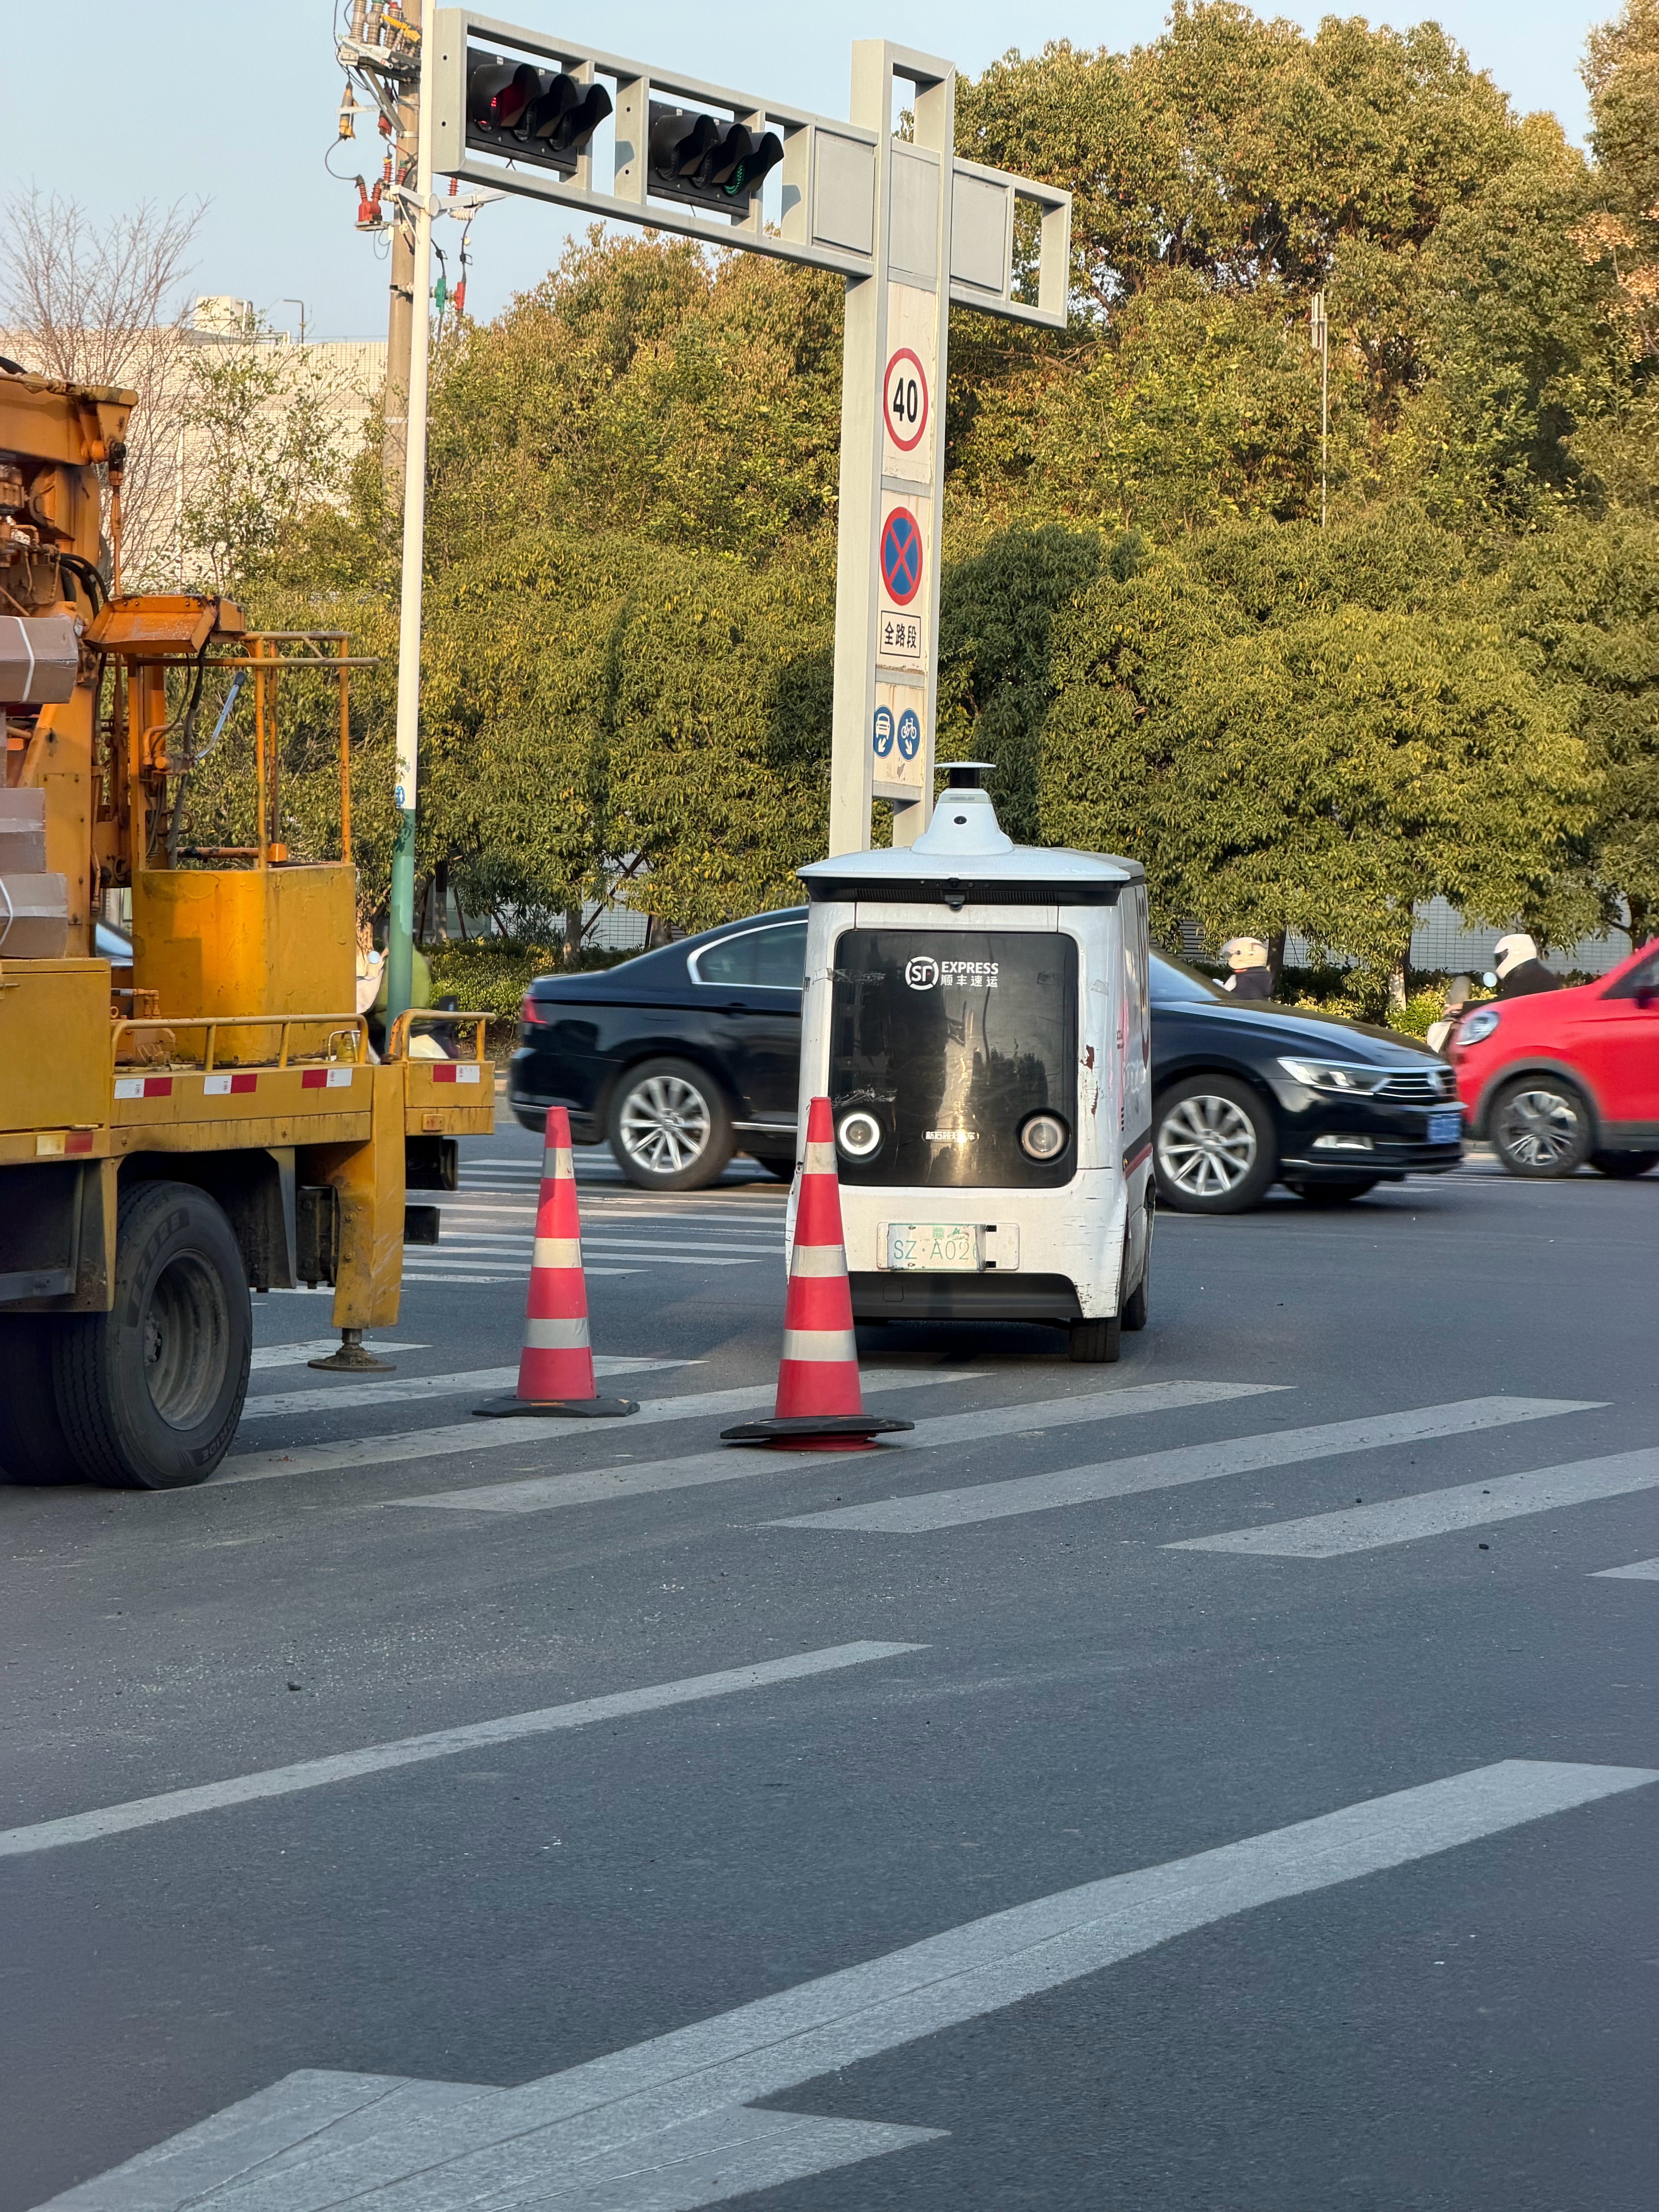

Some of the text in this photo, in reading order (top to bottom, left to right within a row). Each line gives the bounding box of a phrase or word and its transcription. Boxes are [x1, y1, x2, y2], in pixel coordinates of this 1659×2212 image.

[893, 377, 918, 423] 40
[884, 621, 917, 649] 全路段
[941, 961, 999, 975] EXPRESS
[941, 974, 998, 988] 顺丰速运
[926, 1131, 975, 1140] 新石器无车
